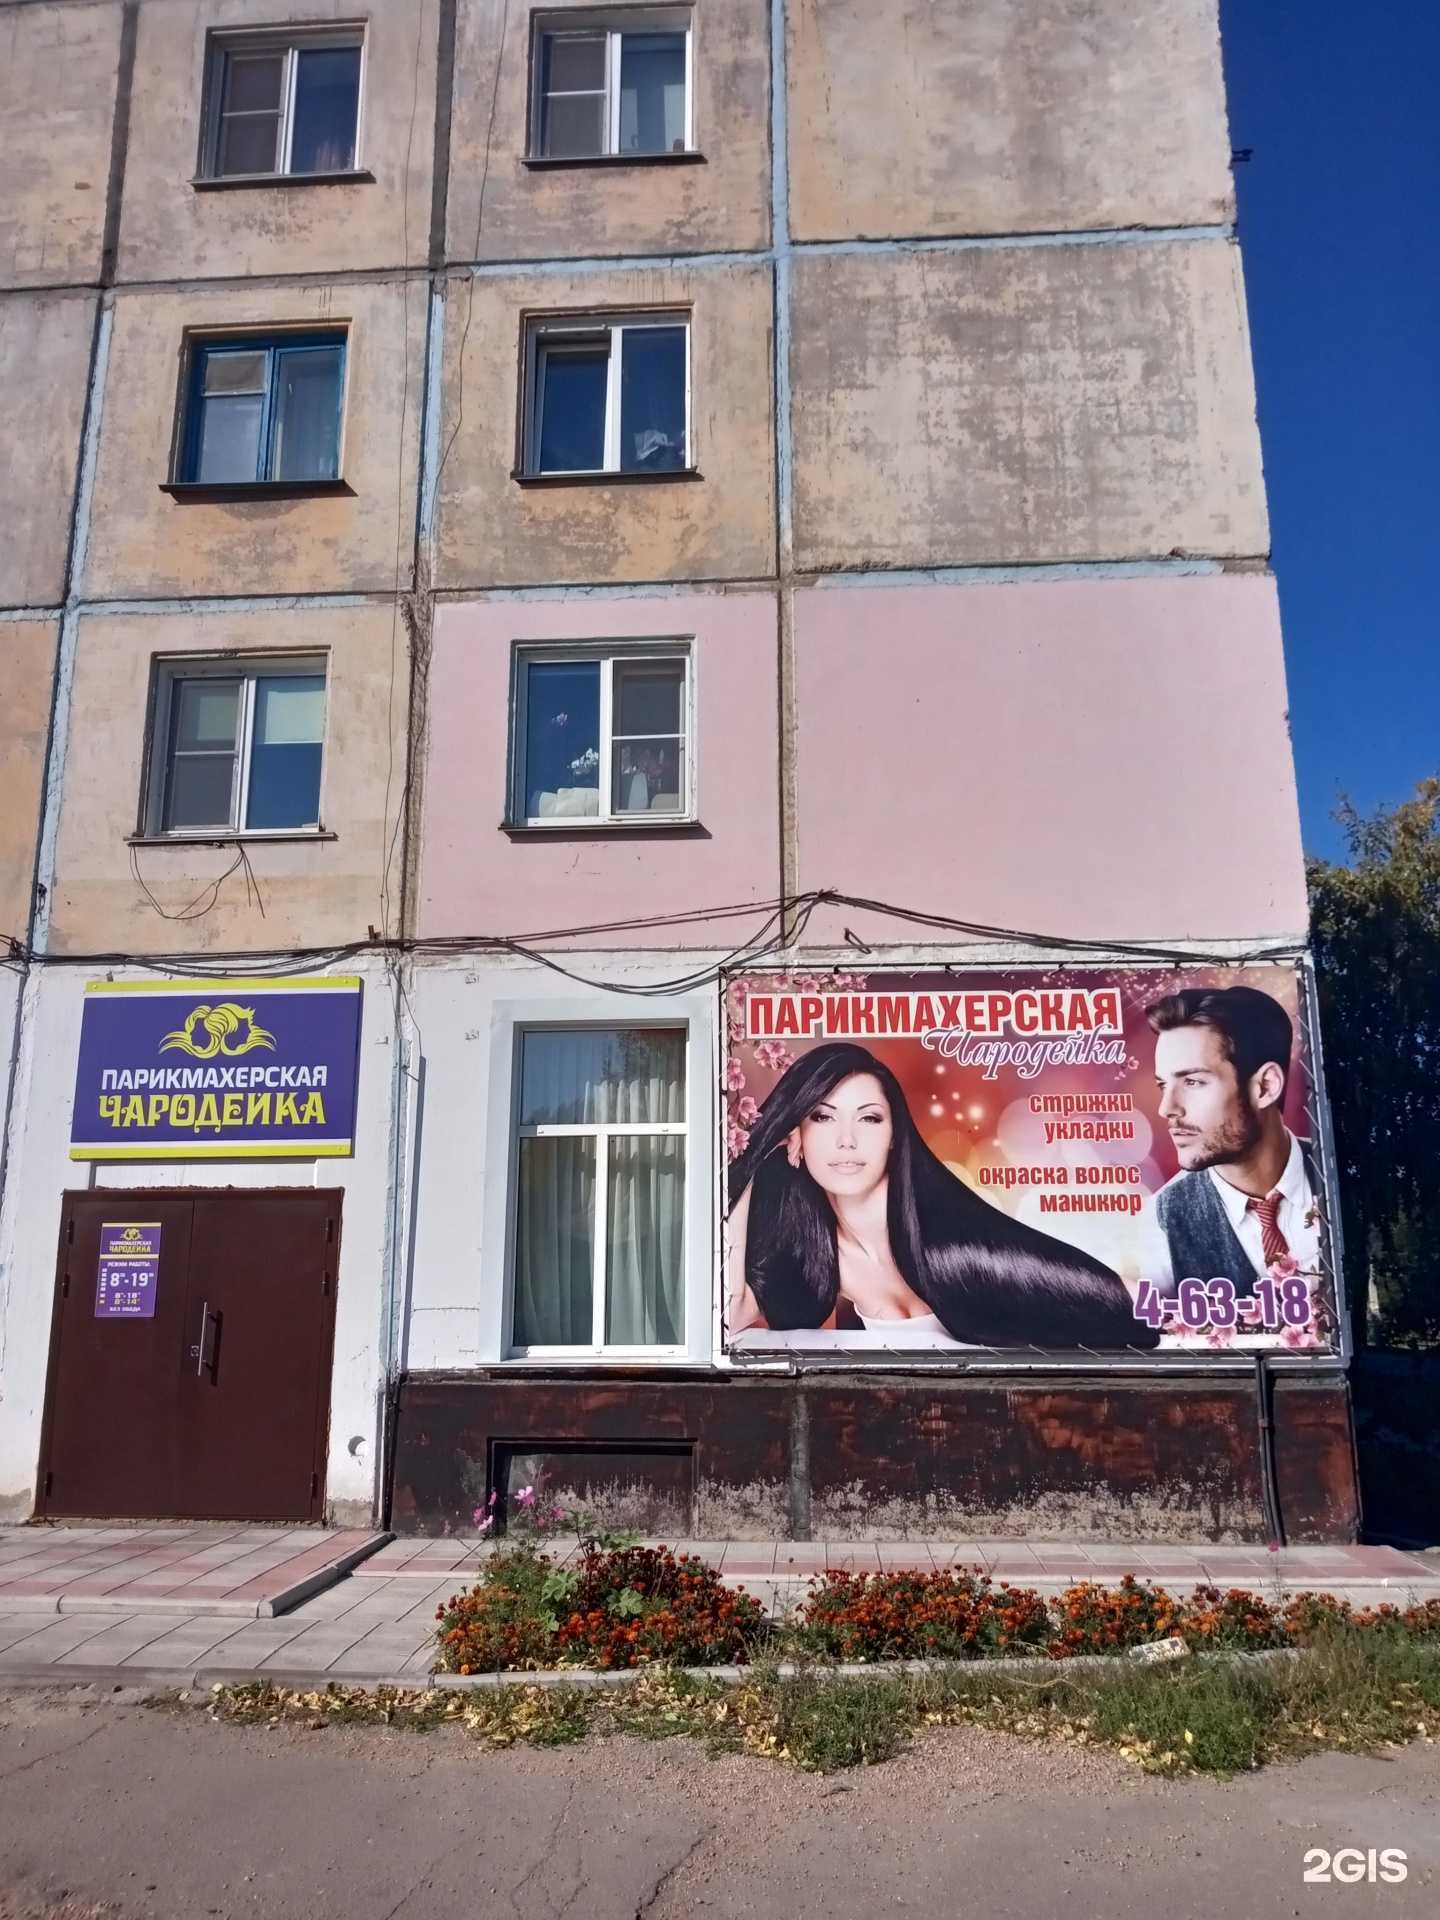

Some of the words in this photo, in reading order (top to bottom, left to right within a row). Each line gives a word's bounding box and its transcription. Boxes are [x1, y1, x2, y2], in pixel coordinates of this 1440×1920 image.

[750, 992, 1119, 1036] ПАРИКМАХЕРСКАЯ
[922, 1024, 1126, 1080] Чародейка
[101, 1065, 328, 1090] ПАРИКМАХЕРСКАЯ
[99, 1091, 327, 1133] ЧАРОДЕЙКА
[1030, 1094, 1133, 1116] стрижки
[1044, 1121, 1134, 1144] укладки
[979, 1166, 1069, 1189] окраска
[1075, 1166, 1141, 1185] волос
[1040, 1193, 1142, 1215] маникюр
[1134, 1277, 1312, 1328] 4-63-18
